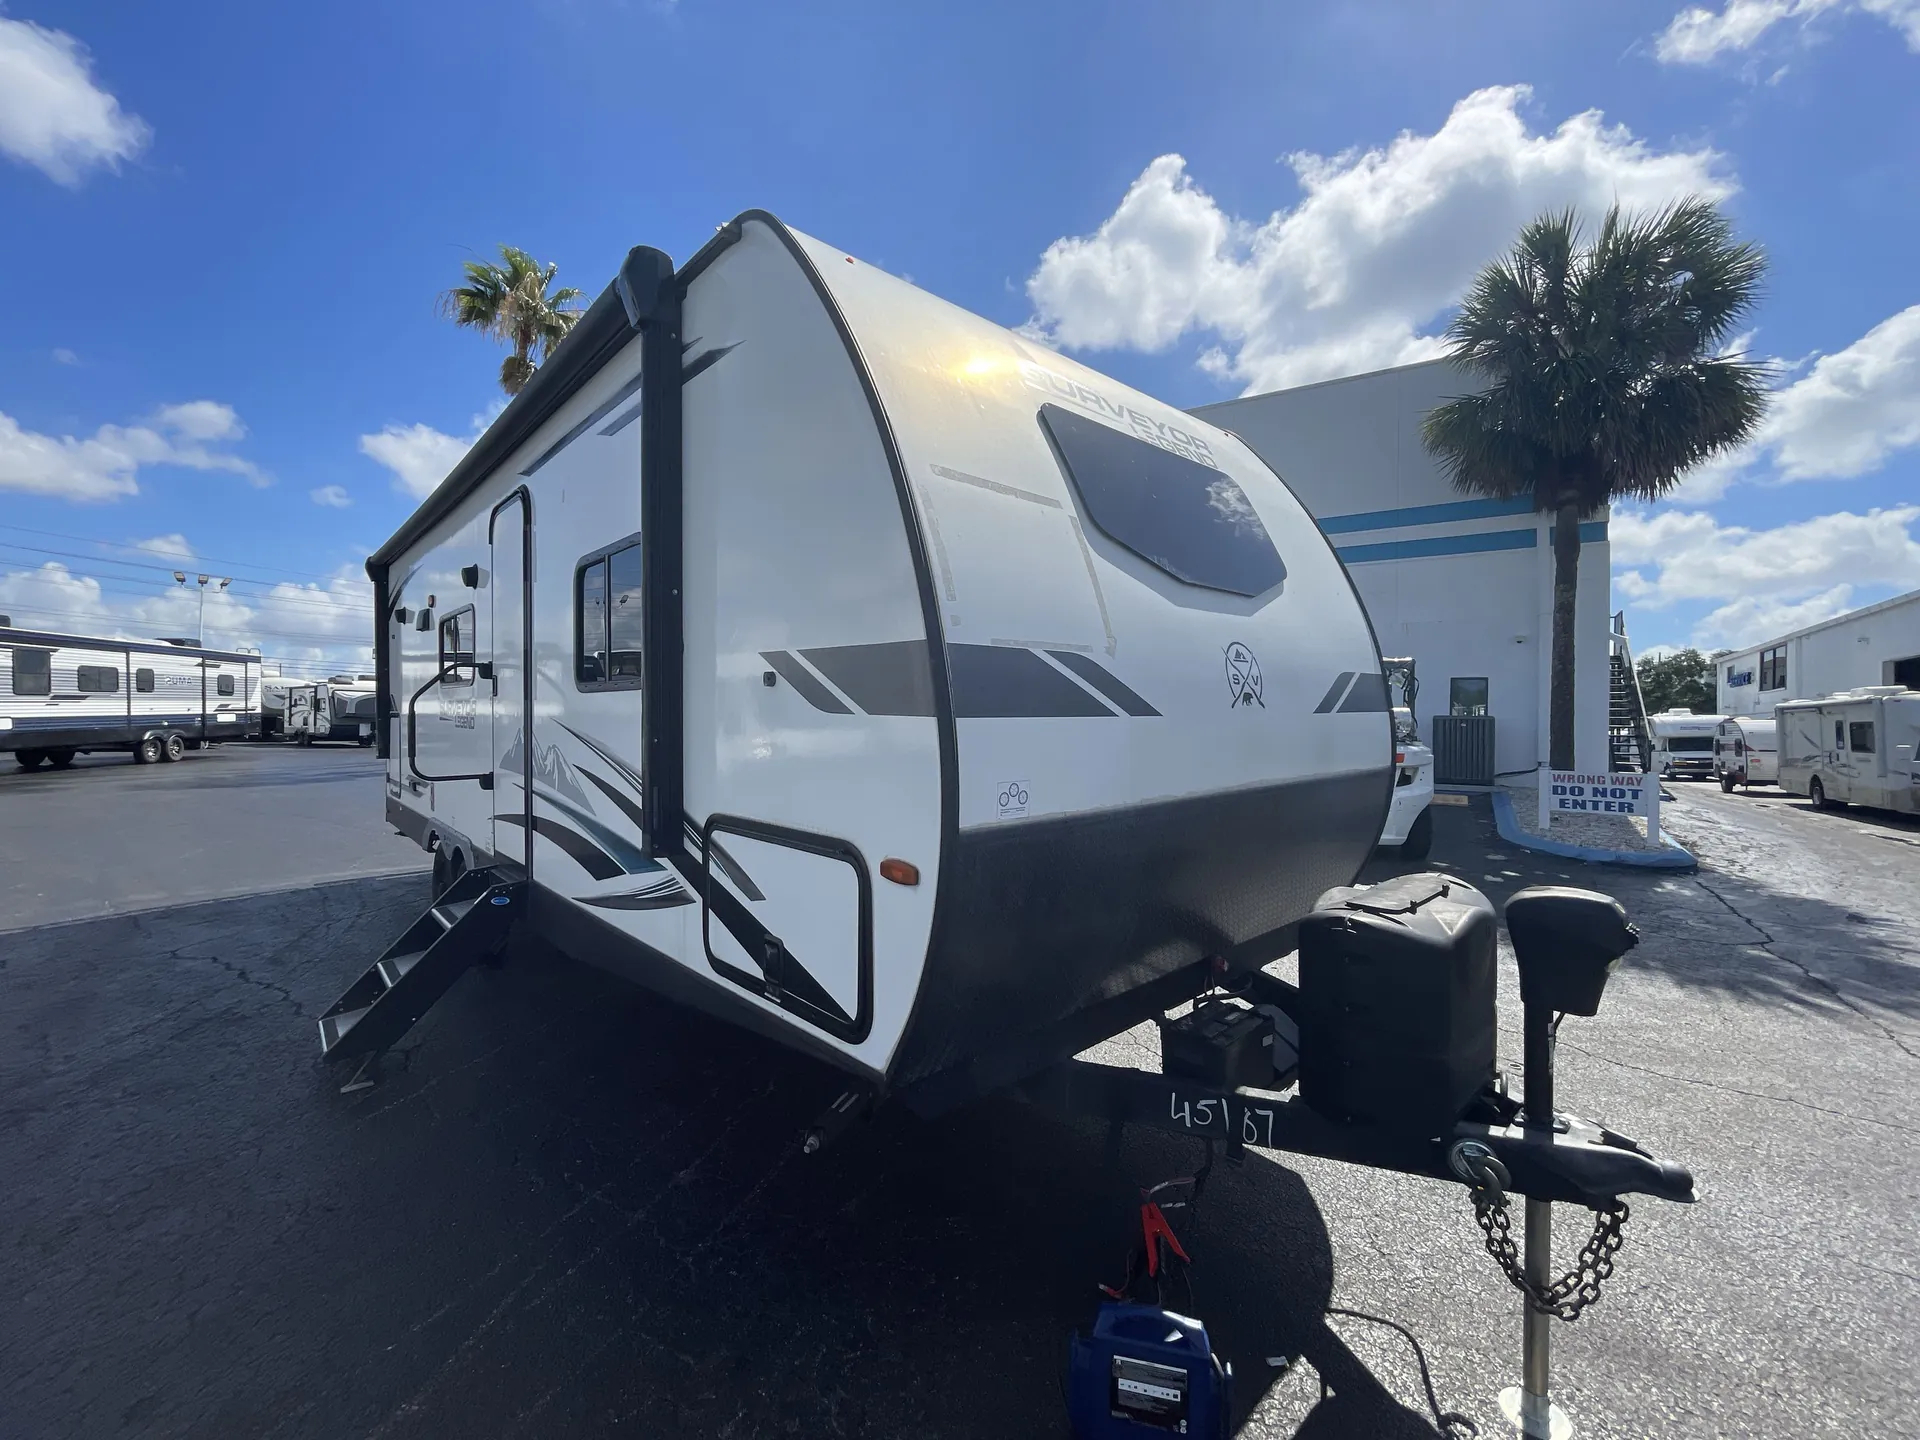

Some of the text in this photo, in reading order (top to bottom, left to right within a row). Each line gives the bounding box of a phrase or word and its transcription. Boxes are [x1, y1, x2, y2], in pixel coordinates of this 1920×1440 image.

[1552, 773, 1644, 787] WRONG WAY
[1552, 784, 1643, 800] DO NOT
[1558, 798, 1635, 814] ENTER
